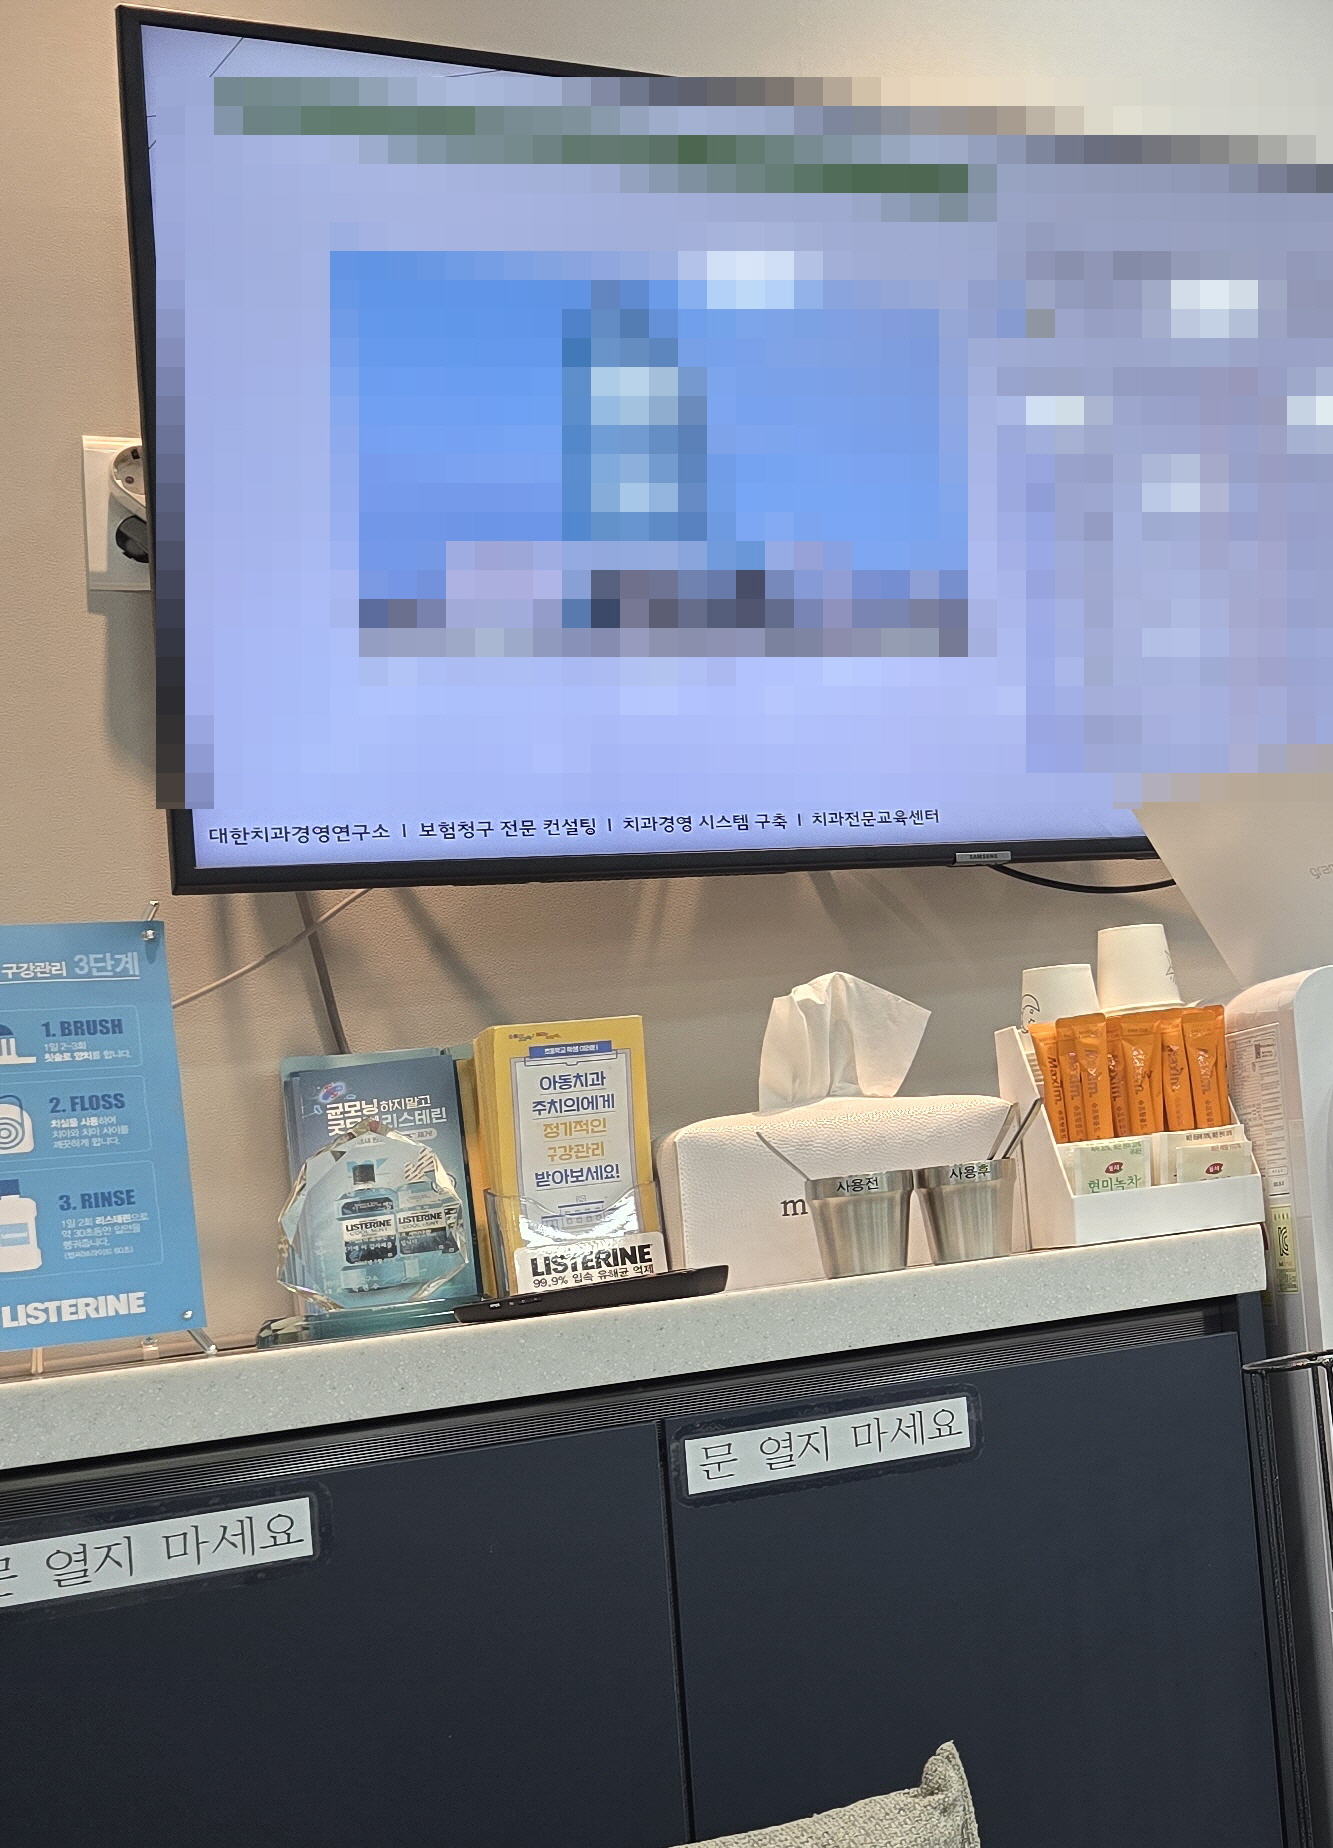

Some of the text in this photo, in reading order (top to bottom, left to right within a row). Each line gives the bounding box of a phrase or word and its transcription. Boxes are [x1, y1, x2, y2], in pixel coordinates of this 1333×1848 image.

[209, 808, 940, 845] 대한치과경영연구소 보험청구 전문 컨설팅 치과경영 시스템 구축 치과전문교육센터
[2, 951, 141, 978] 구강관리 3단계
[41, 1018, 123, 1038] 1. BRUSH
[539, 1071, 606, 1091] 아동치과
[49, 1093, 125, 1113] 2. FLOSS
[326, 1095, 431, 1119] 균모닝 하지말고
[532, 1093, 615, 1116] 주치의에게
[381, 1107, 447, 1128] 리스테린
[543, 1117, 607, 1139] 정기적인
[548, 1141, 605, 1162] 구강관리
[535, 1163, 620, 1188] 받아보세요!
[949, 1163, 991, 1180] 사용후
[836, 1177, 879, 1193] 사용전
[1088, 1175, 1142, 1193] 현미녹차
[58, 1189, 136, 1211] 3. RINSE
[345, 1219, 392, 1232] LISTERINE
[398, 1208, 443, 1225] LISTERINE
[530, 1243, 653, 1277] LISTERINE
[533, 1275, 568, 1288] 99.9%
[572, 1271, 594, 1284] 입속
[632, 1264, 654, 1275] 억제
[2, 1292, 146, 1328] LISTERINE
[699, 1408, 963, 1481] 문 열지 마세요
[46, 1535, 134, 1589] 열지
[161, 1513, 304, 1566] 마세요
